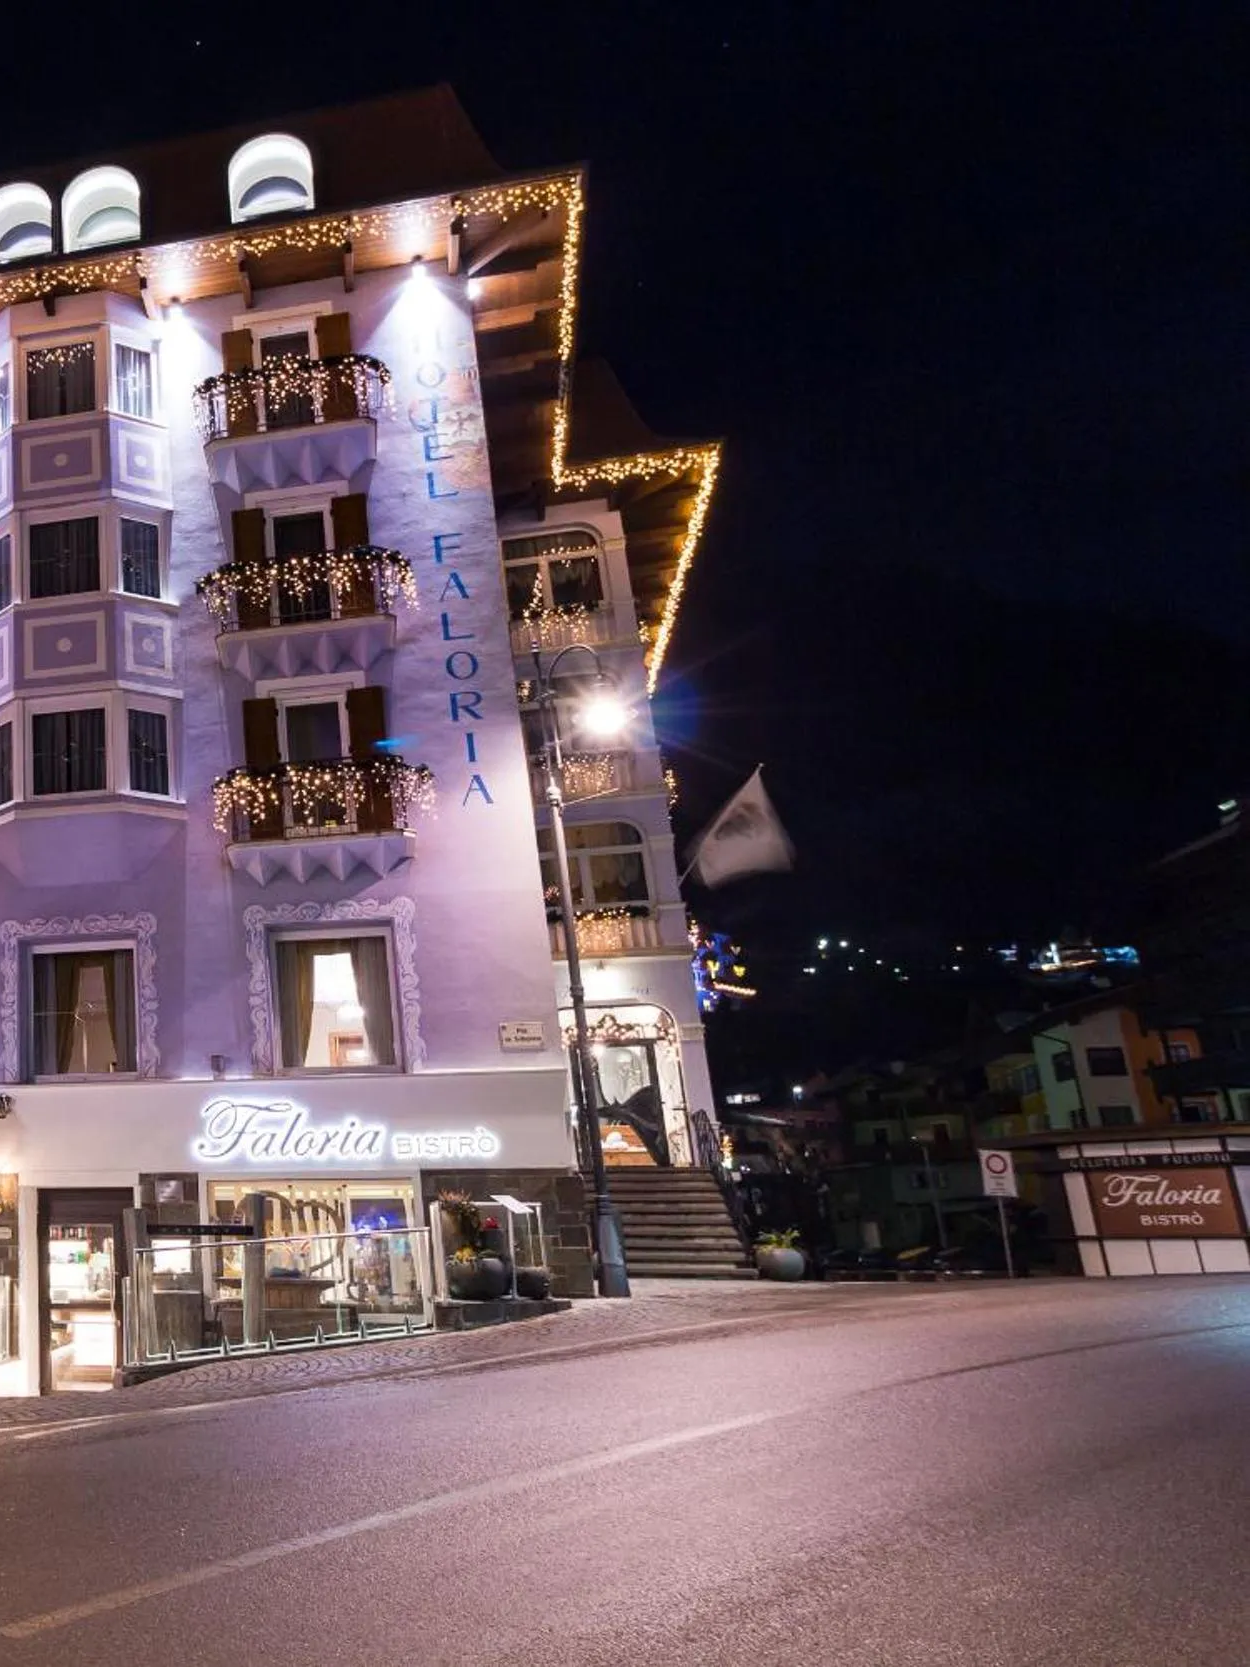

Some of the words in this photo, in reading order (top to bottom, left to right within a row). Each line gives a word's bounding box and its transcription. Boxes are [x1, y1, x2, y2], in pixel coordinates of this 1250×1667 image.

[432, 532, 494, 806] FALORIA
[197, 1100, 380, 1158] Faloria
[395, 1127, 498, 1156] BISTRÒ
[1102, 1173, 1223, 1207] Faloria
[1139, 1211, 1205, 1227] BISTRÒ
